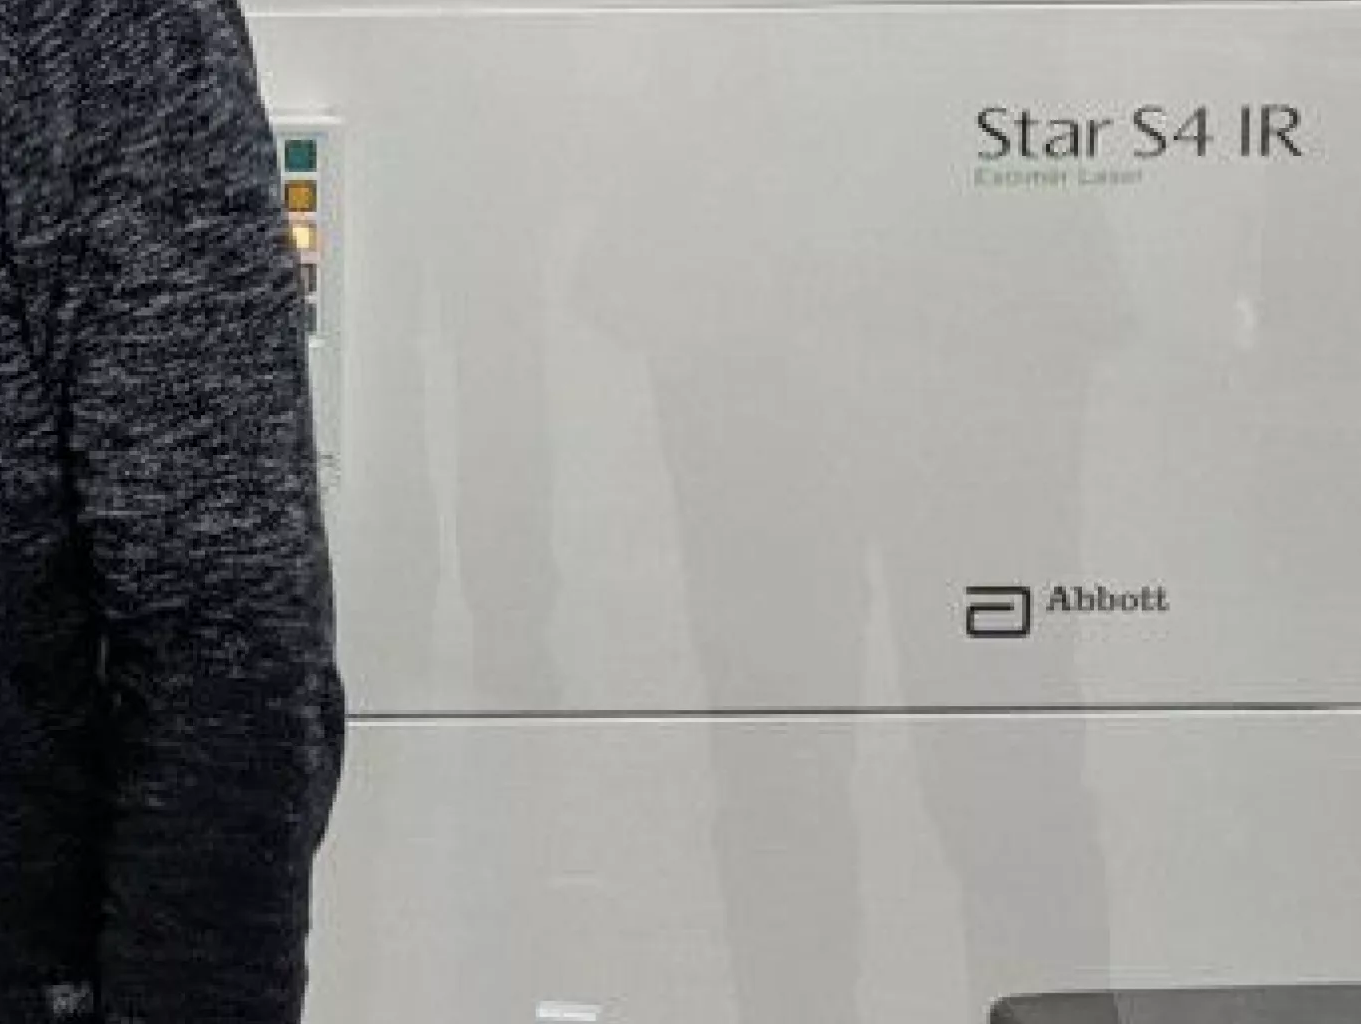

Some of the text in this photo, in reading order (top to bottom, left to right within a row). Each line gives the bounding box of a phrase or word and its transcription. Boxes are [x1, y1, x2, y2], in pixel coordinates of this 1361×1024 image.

[976, 104, 1304, 160] Star S4 IR
[1045, 585, 1170, 612] Abbott
